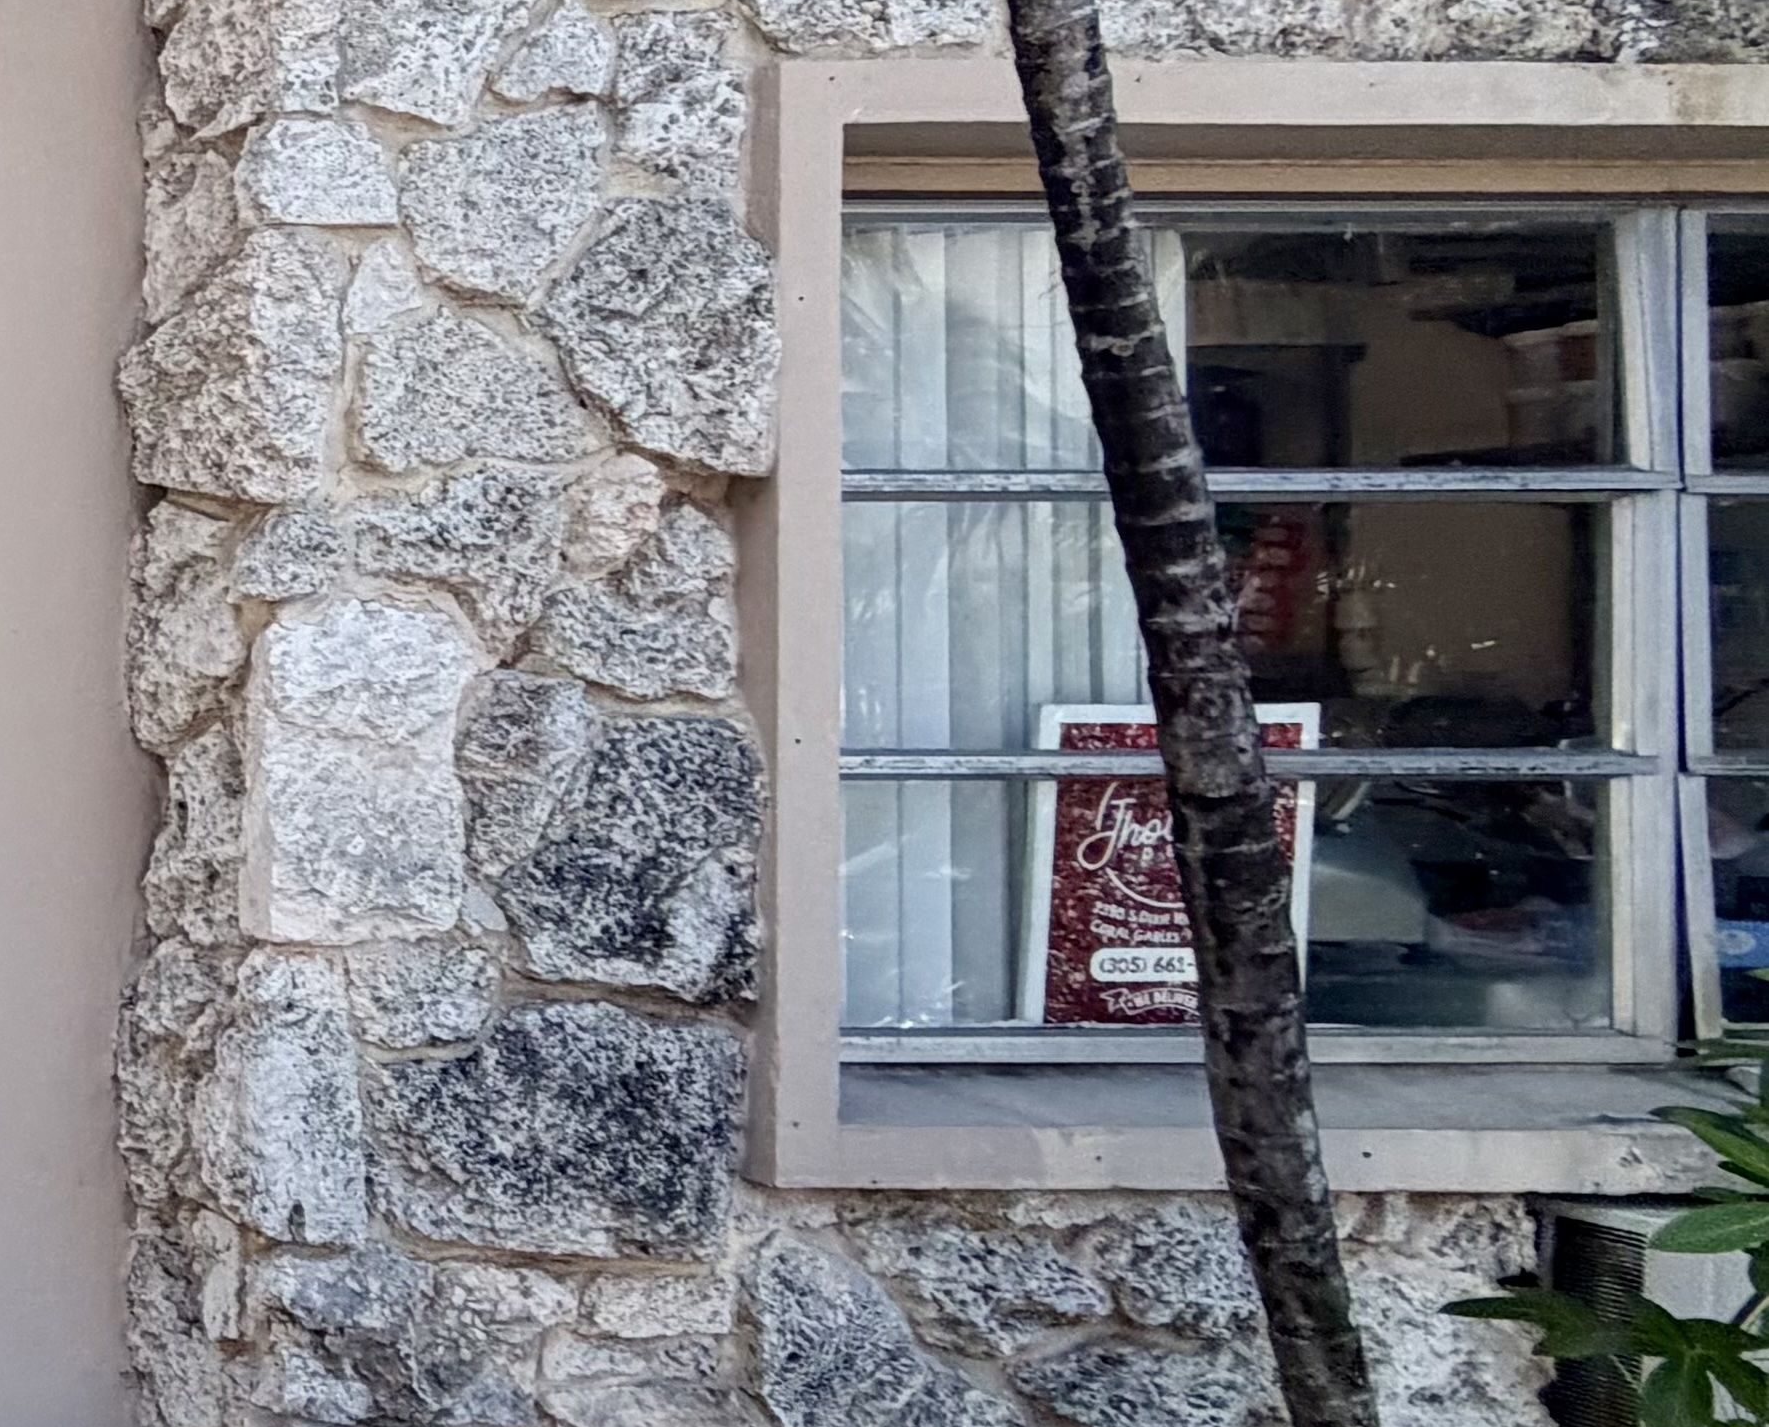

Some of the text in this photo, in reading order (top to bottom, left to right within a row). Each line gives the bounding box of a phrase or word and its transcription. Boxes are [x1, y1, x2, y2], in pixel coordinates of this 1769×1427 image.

[1089, 919, 1181, 943] CORAL GABLES
[1099, 956, 1147, 974] (305)
